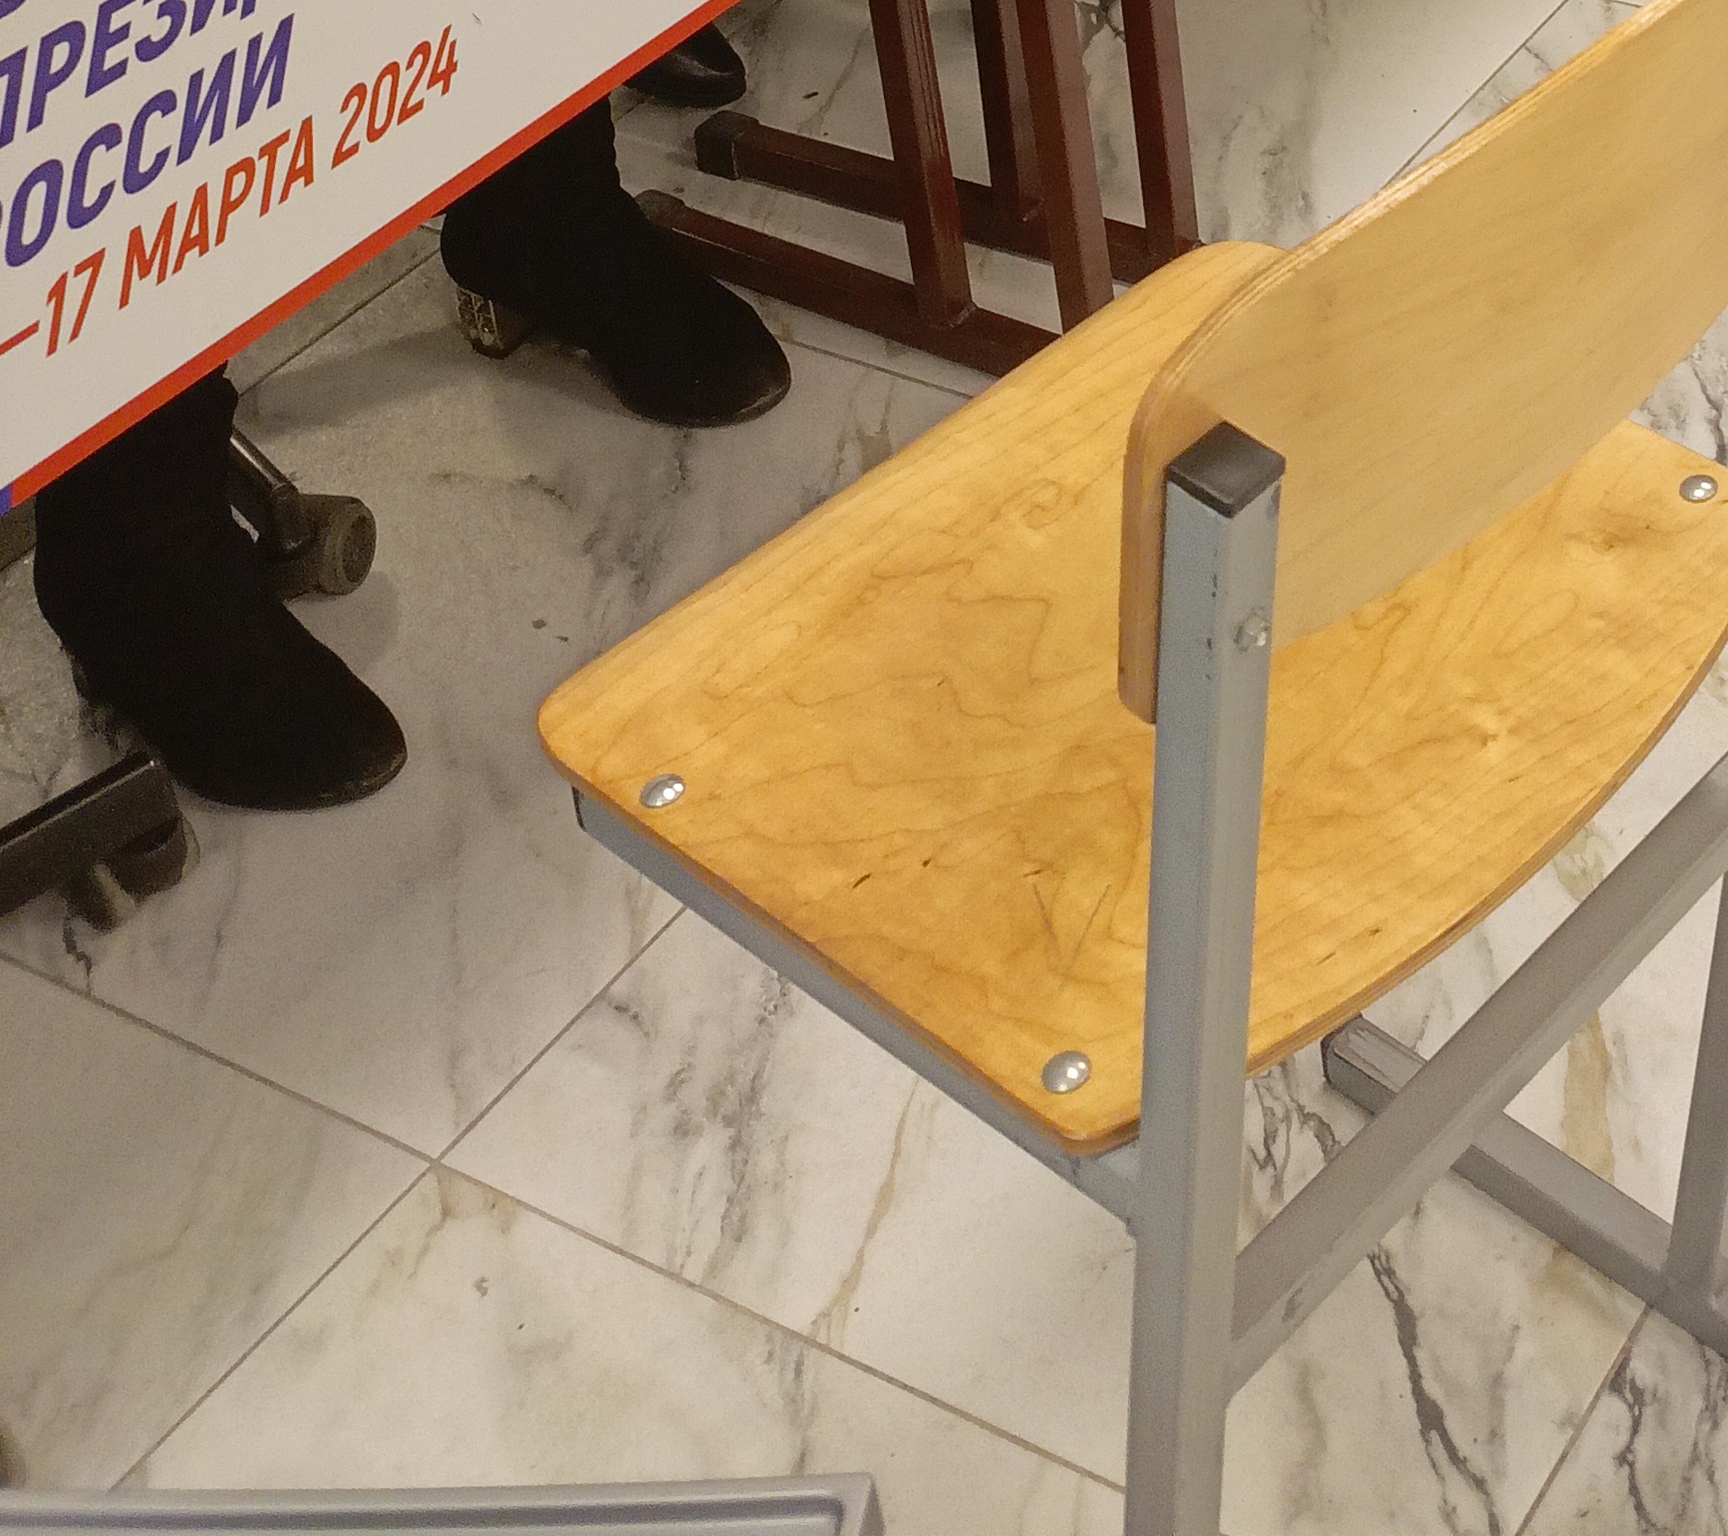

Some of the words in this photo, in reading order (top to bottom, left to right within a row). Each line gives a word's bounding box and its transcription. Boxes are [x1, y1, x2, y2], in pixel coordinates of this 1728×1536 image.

[0, 12, 295, 268] ОССИИ
[118, 114, 314, 311] МАРТА
[330, 23, 459, 169] 2024
